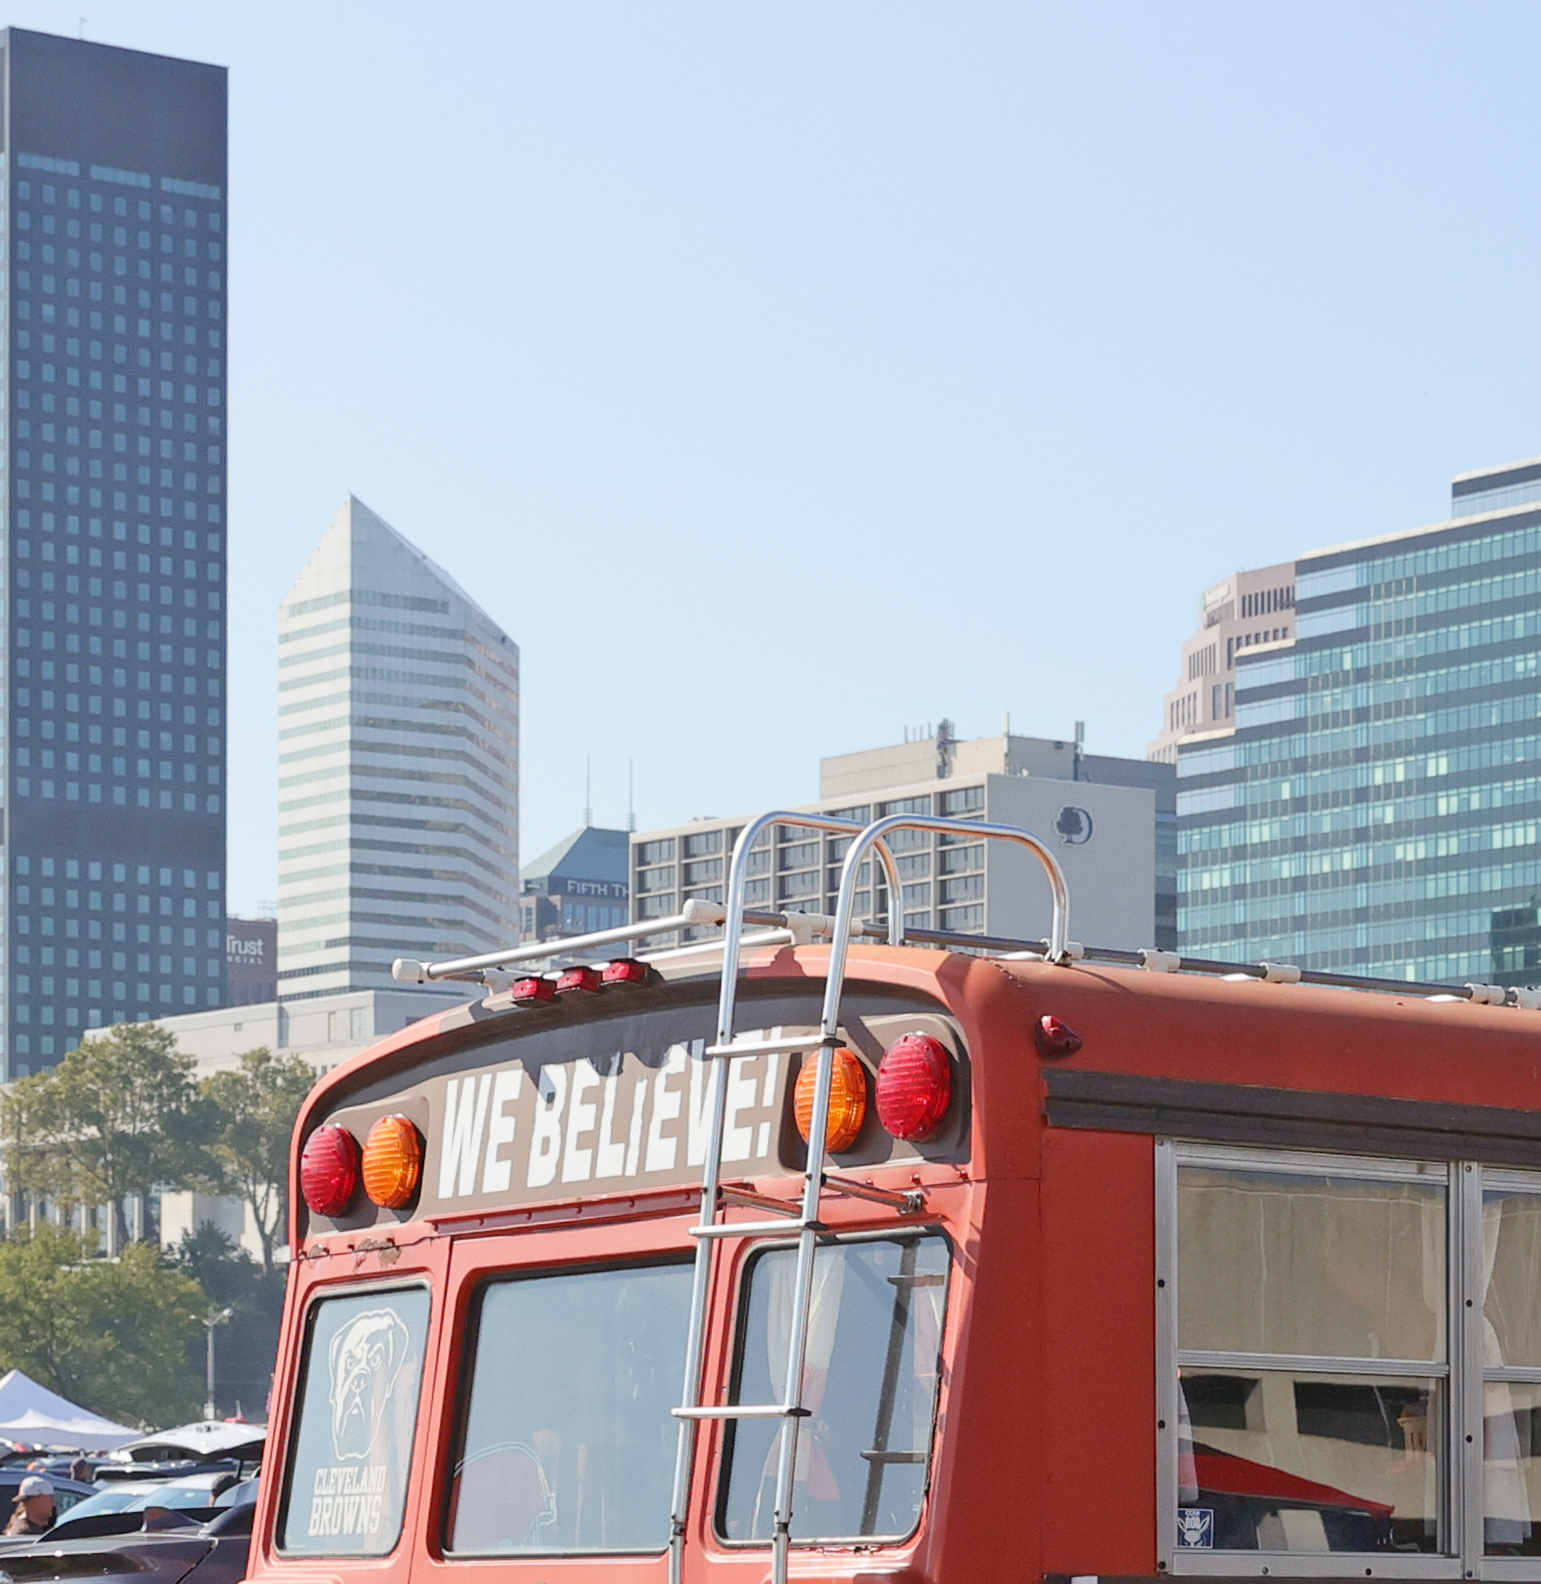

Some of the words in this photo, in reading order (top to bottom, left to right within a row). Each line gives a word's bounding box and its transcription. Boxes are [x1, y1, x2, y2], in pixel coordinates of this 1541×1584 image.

[567, 880, 608, 895] FIFTH
[438, 1069, 523, 1199] WE
[526, 1026, 783, 1189] BELIEVE!
[314, 1465, 387, 1495] CLEVELAND
[308, 1494, 383, 1536] BROWNS
